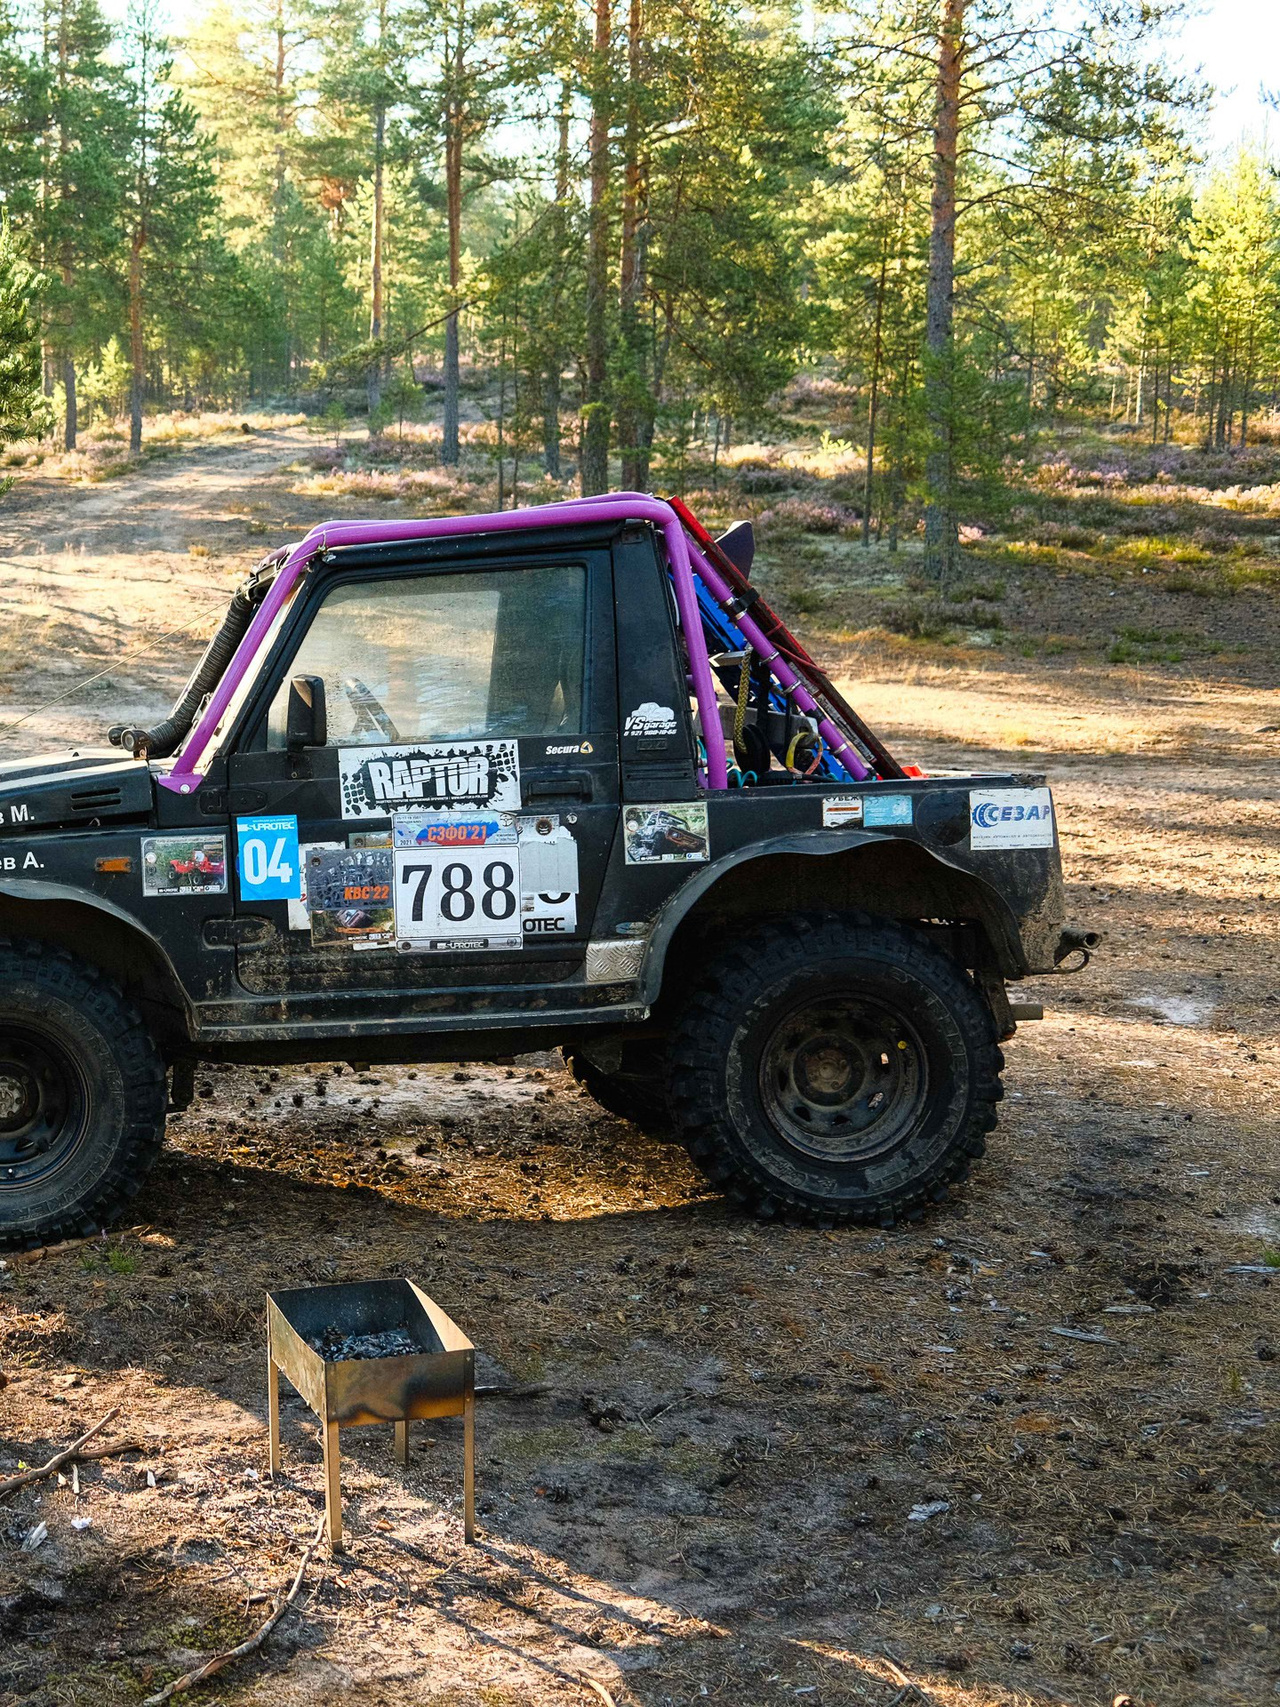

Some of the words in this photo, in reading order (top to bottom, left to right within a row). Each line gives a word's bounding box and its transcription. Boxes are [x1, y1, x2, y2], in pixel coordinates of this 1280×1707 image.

[625, 716, 646, 730] VS
[643, 721, 677, 733] garage
[546, 745, 579, 755] Secura
[368, 756, 489, 799] RAPTOR
[10, 804, 36, 824] М.
[988, 805, 1050, 822] СЕЗАР
[248, 821, 295, 831] SUPROTEC
[427, 825, 487, 841] СЗФО'21
[22, 851, 45, 869] А.
[243, 837, 293, 885] 04
[402, 861, 517, 922] 788
[446, 940, 484, 949] SUPROTEC
